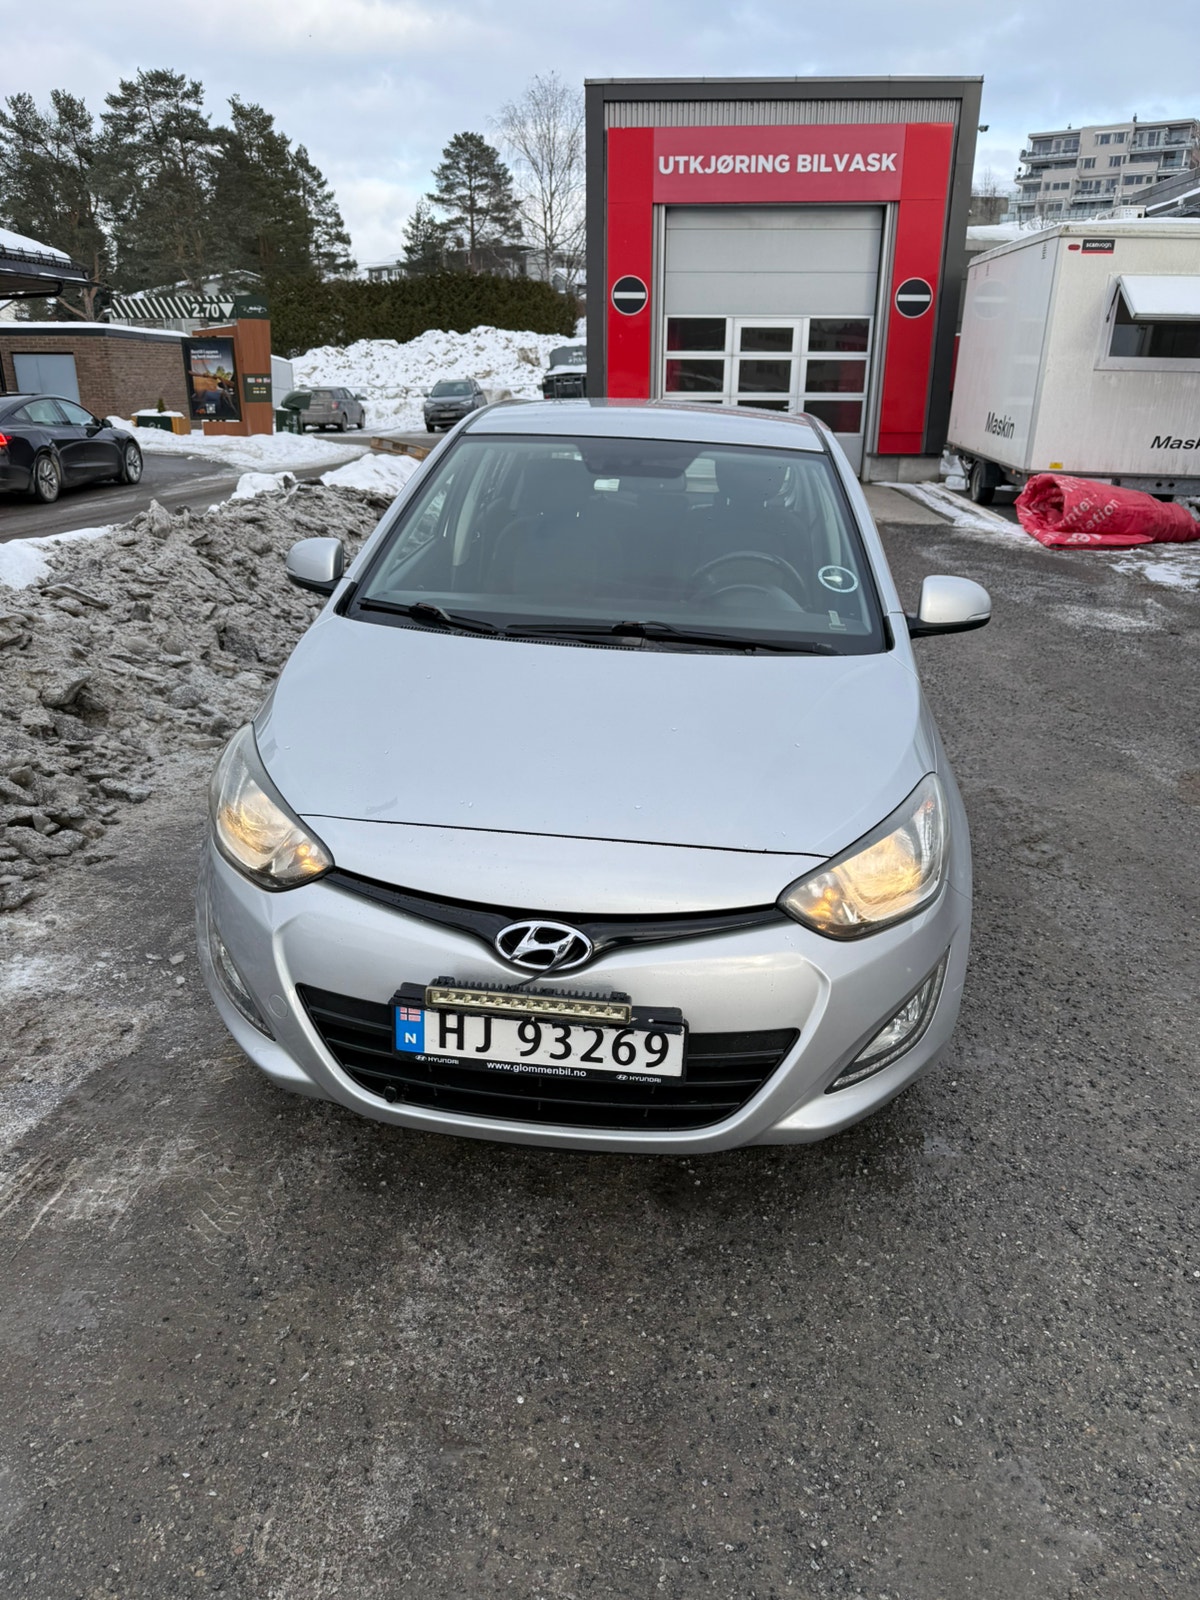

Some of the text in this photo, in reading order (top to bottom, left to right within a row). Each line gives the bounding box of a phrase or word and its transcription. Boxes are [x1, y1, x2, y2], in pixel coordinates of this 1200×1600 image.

[658, 153, 898, 175] UTKJØRING BILVASK
[191, 303, 220, 318] 2.70
[984, 411, 1015, 440] Maskin
[404, 1032, 417, 1044] N
[438, 1009, 669, 1068] HJ 93269
[427, 1056, 460, 1065] HYUNDAI
[486, 1061, 587, 1077] www.glommenbil.no
[629, 1075, 662, 1083] HYUNDAI
